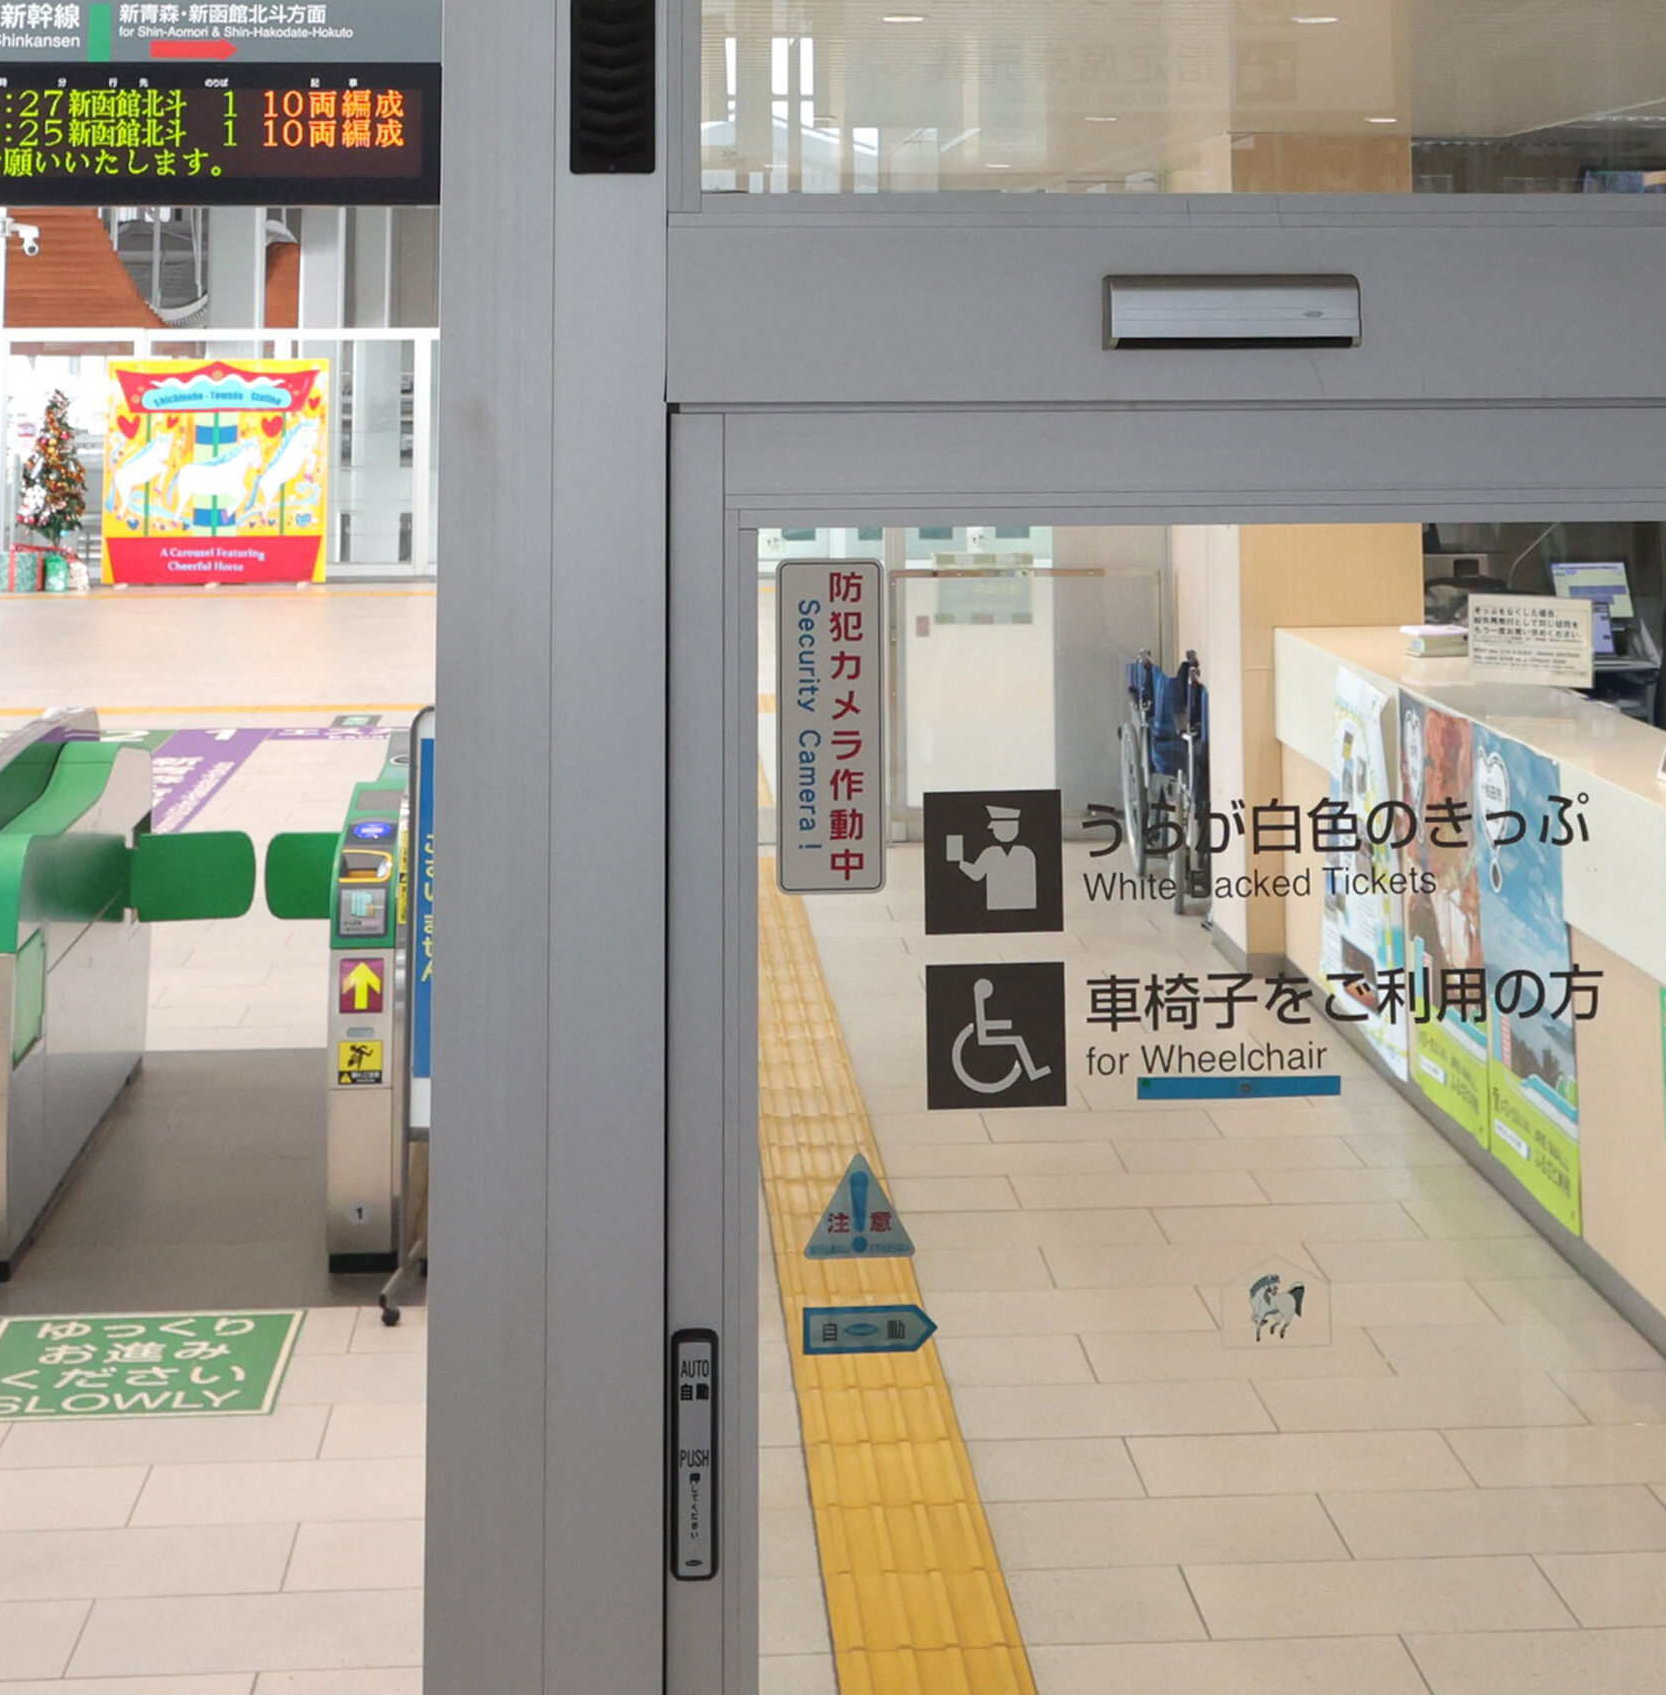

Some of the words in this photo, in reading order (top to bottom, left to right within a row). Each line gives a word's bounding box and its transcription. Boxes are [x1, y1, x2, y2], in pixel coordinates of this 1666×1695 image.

[119, 4, 326, 26] 新青森・新函館北斗方面
[119, 26, 134, 39] for
[137, 26, 209, 39] Shin-Aomori
[211, 26, 221, 39] &
[224, 25, 354, 40] Shin-Hakodate-Hokuto
[68, 90, 188, 117] 新函館北斗
[222, 90, 238, 117] 1
[264, 90, 405, 117] 10両編成
[68, 120, 188, 147] 新函館北斗
[222, 120, 238, 147] 1
[264, 120, 405, 147] 10両編成
[167, 561, 211, 573] Cheerful
[169, 548, 214, 559] Carousel
[216, 548, 266, 562] Featuring
[797, 599, 822, 714] Security
[828, 571, 865, 882] 防犯カメラ作動中
[1082, 791, 1591, 861] うらが白色のきっぷ
[1083, 870, 1177, 902] White
[1190, 867, 1312, 901] Backed
[1323, 864, 1438, 898] Tickets
[1086, 963, 1604, 1032] 車椅子をご利用の方
[1086, 1044, 1133, 1077] for
[1141, 1040, 1329, 1075] Wheelchair
[37, 1317, 255, 1342] ゆっくり
[40, 1341, 232, 1366] お進み
[0, 1364, 247, 1391] ください
[680, 1359, 710, 1379] AUTO
[680, 1383, 710, 1401] 自動
[679, 1448, 710, 1468] PUSH
